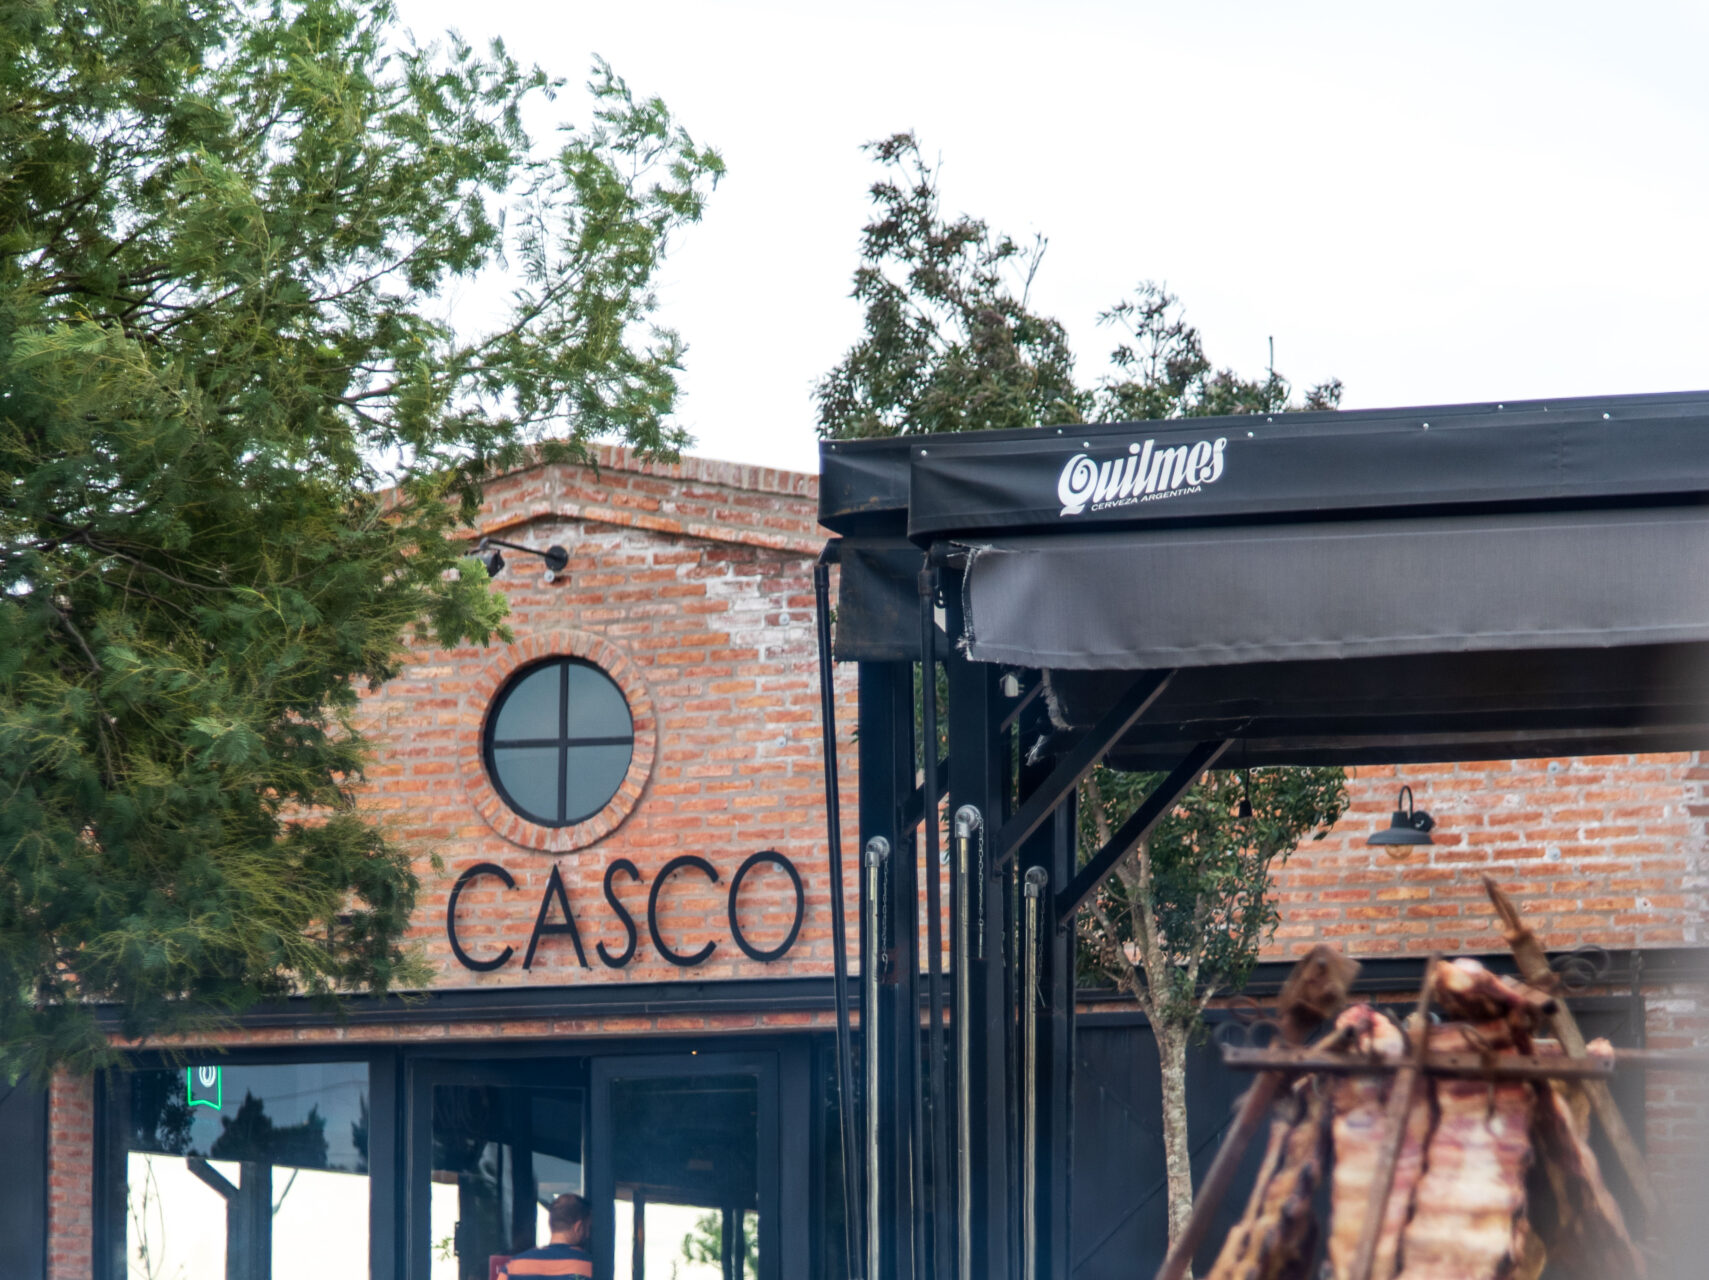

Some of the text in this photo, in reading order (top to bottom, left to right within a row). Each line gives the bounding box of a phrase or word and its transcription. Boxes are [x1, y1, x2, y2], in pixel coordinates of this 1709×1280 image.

[1058, 437, 1228, 517] Quilmes
[1091, 485, 1203, 512] CERVEZA ARGENTINA
[447, 851, 805, 972] CASCO
